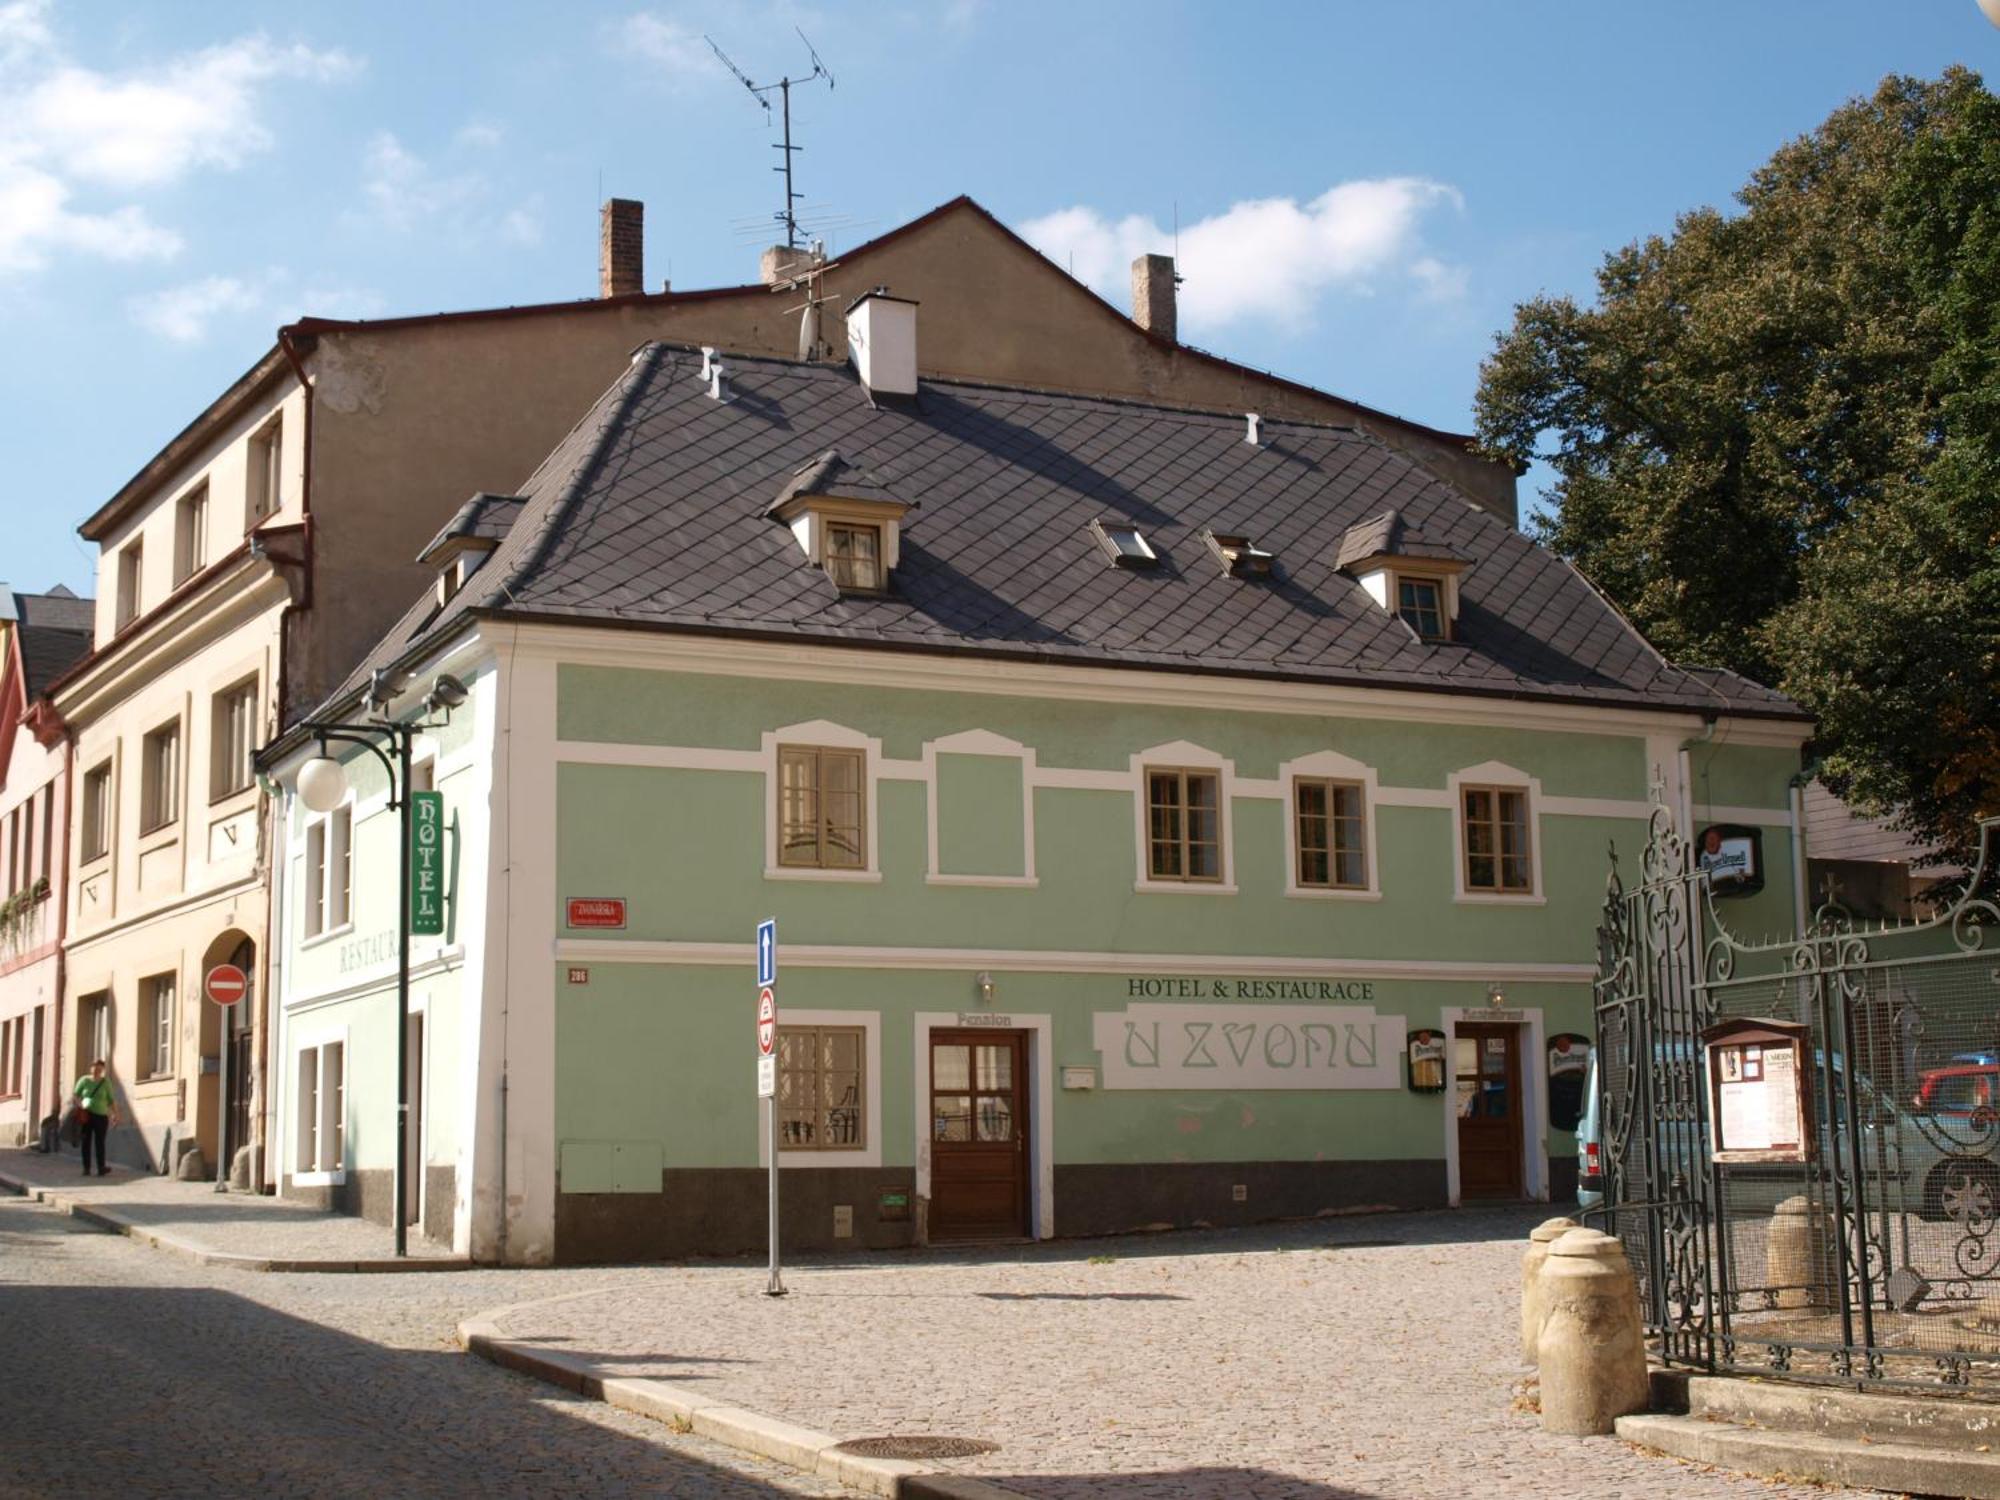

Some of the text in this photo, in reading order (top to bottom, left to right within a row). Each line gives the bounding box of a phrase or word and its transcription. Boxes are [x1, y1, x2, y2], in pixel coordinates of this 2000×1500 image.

[417, 799, 436, 915] HOTEL
[570, 970, 586, 982] 286
[1127, 978, 1375, 1000] HOTEL & RESTAURACE
[1123, 1021, 1161, 1068] U
